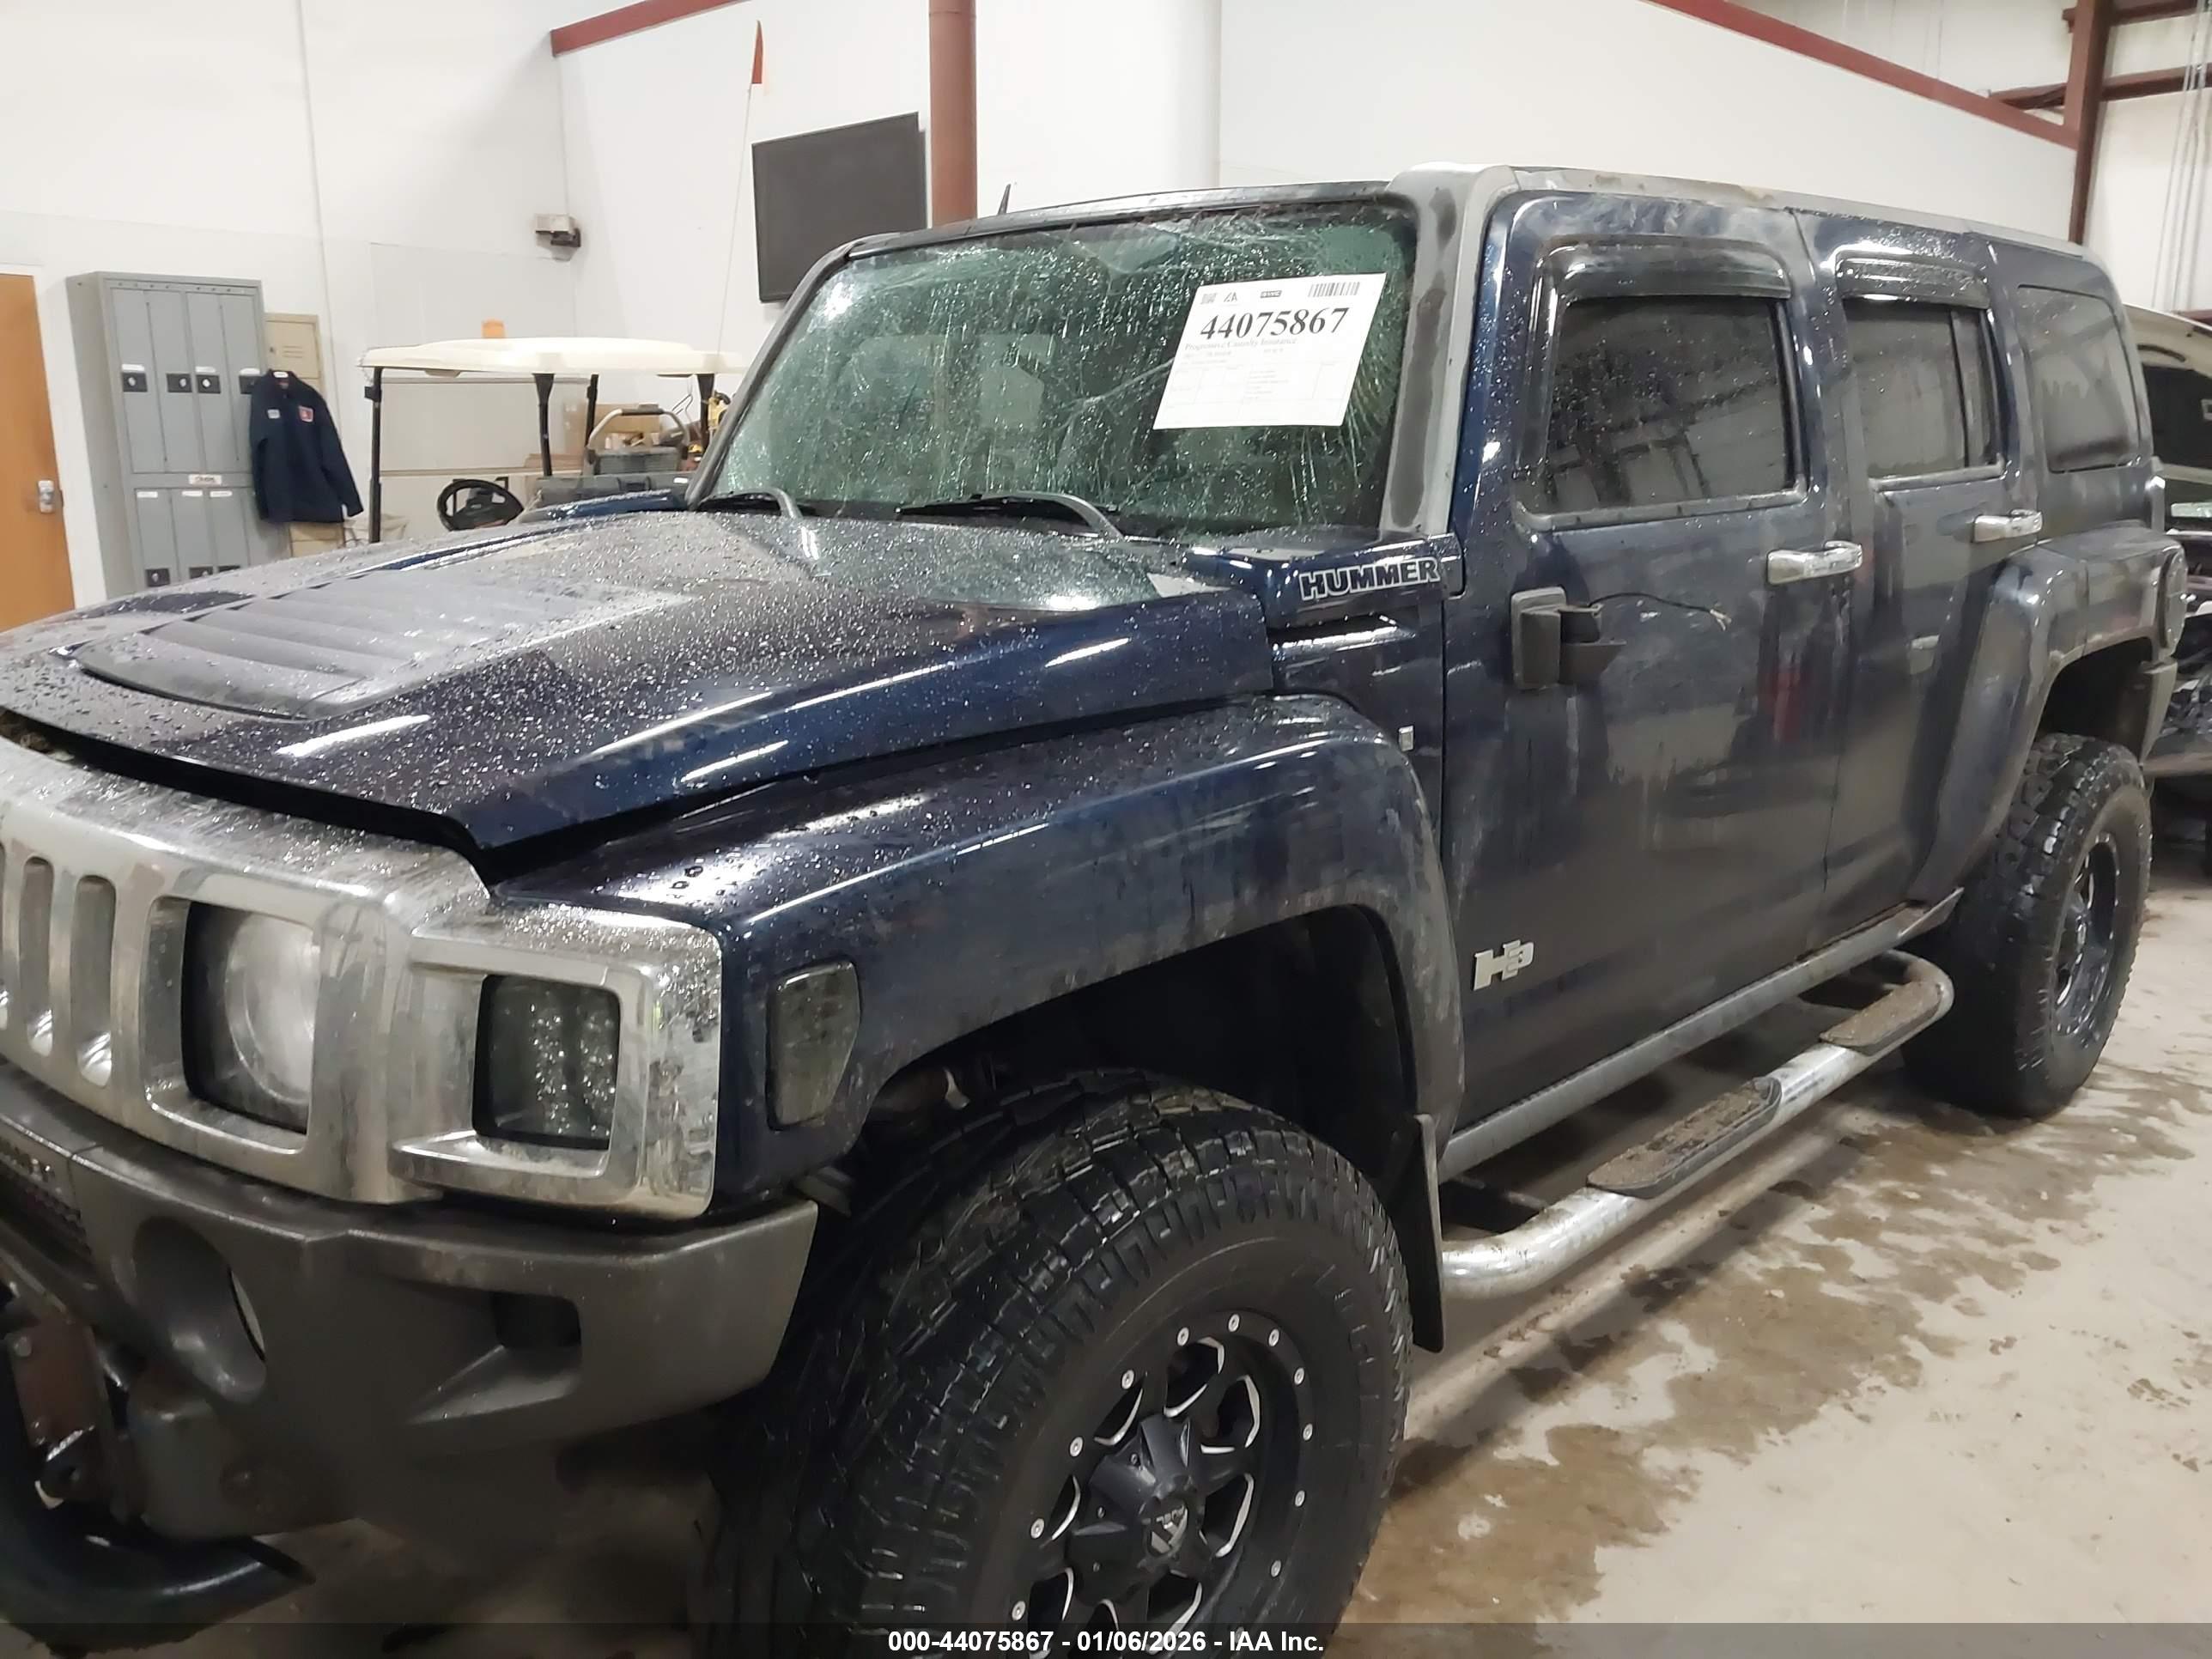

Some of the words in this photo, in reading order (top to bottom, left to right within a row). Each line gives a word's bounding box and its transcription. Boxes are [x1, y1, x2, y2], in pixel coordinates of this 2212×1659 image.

[1200, 307, 1350, 340] 44075867
[1299, 557, 1441, 600] HUMMER
[1474, 939, 1534, 991] H3
